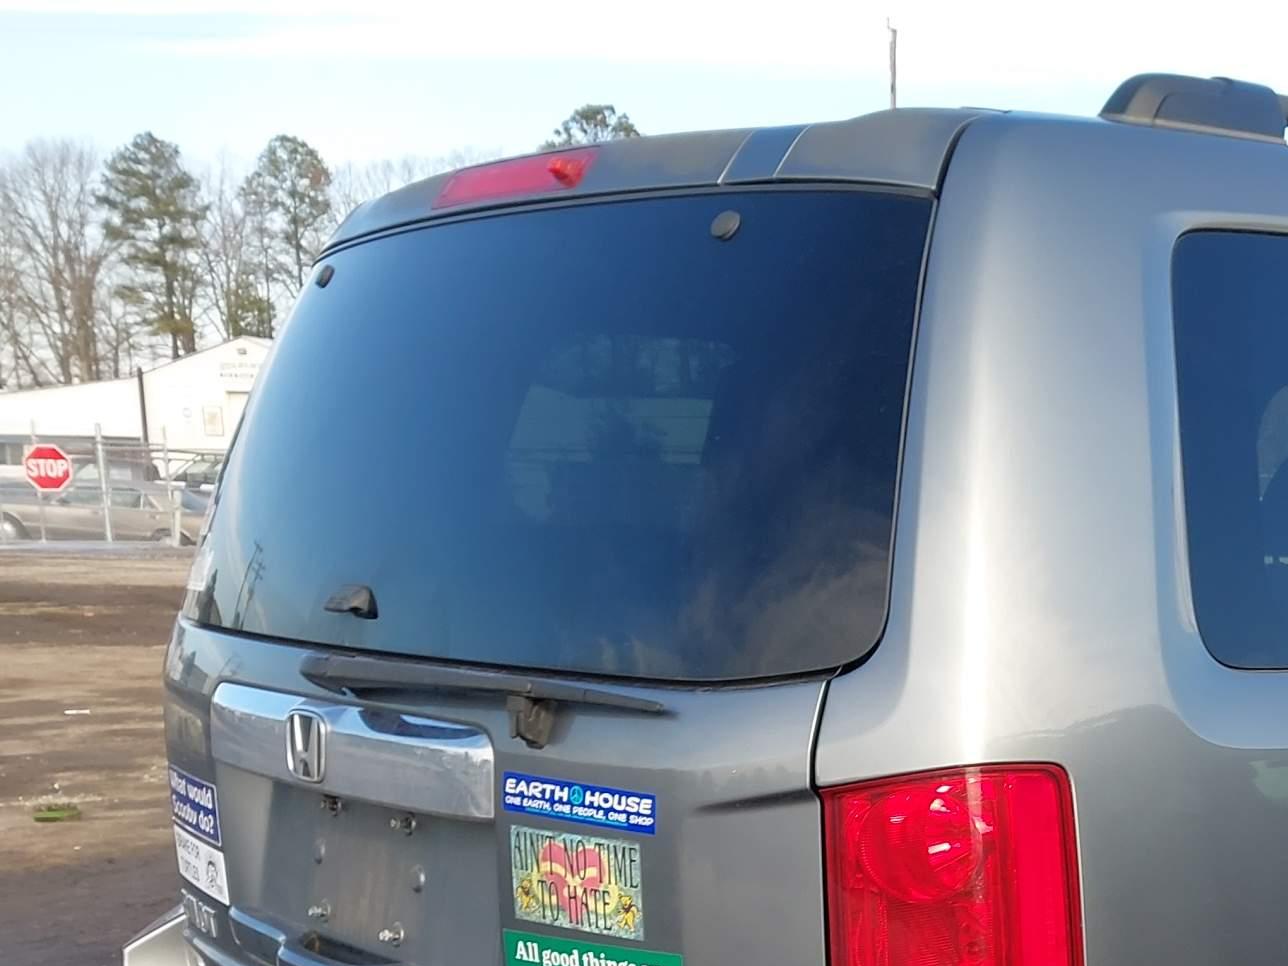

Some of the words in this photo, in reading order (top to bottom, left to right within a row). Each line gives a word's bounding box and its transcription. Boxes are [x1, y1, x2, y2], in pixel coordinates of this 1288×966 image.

[27, 458, 68, 478] STOP
[187, 783, 213, 810] would
[505, 778, 569, 802] EARTH
[584, 790, 653, 815] HOUSE
[505, 795, 521, 806] ONE
[522, 798, 552, 811] EARTH,
[553, 803, 571, 814] ONE
[572, 805, 606, 820] PEOPLE,
[608, 811, 627, 823] ONE
[628, 814, 654, 826] SHOP
[198, 810, 214, 835] do?
[514, 831, 555, 875] AIN'T
[562, 837, 588, 881] NO
[594, 842, 640, 889] TIME
[537, 880, 560, 922] TO
[566, 884, 613, 931] HATE
[515, 940, 540, 963] All
